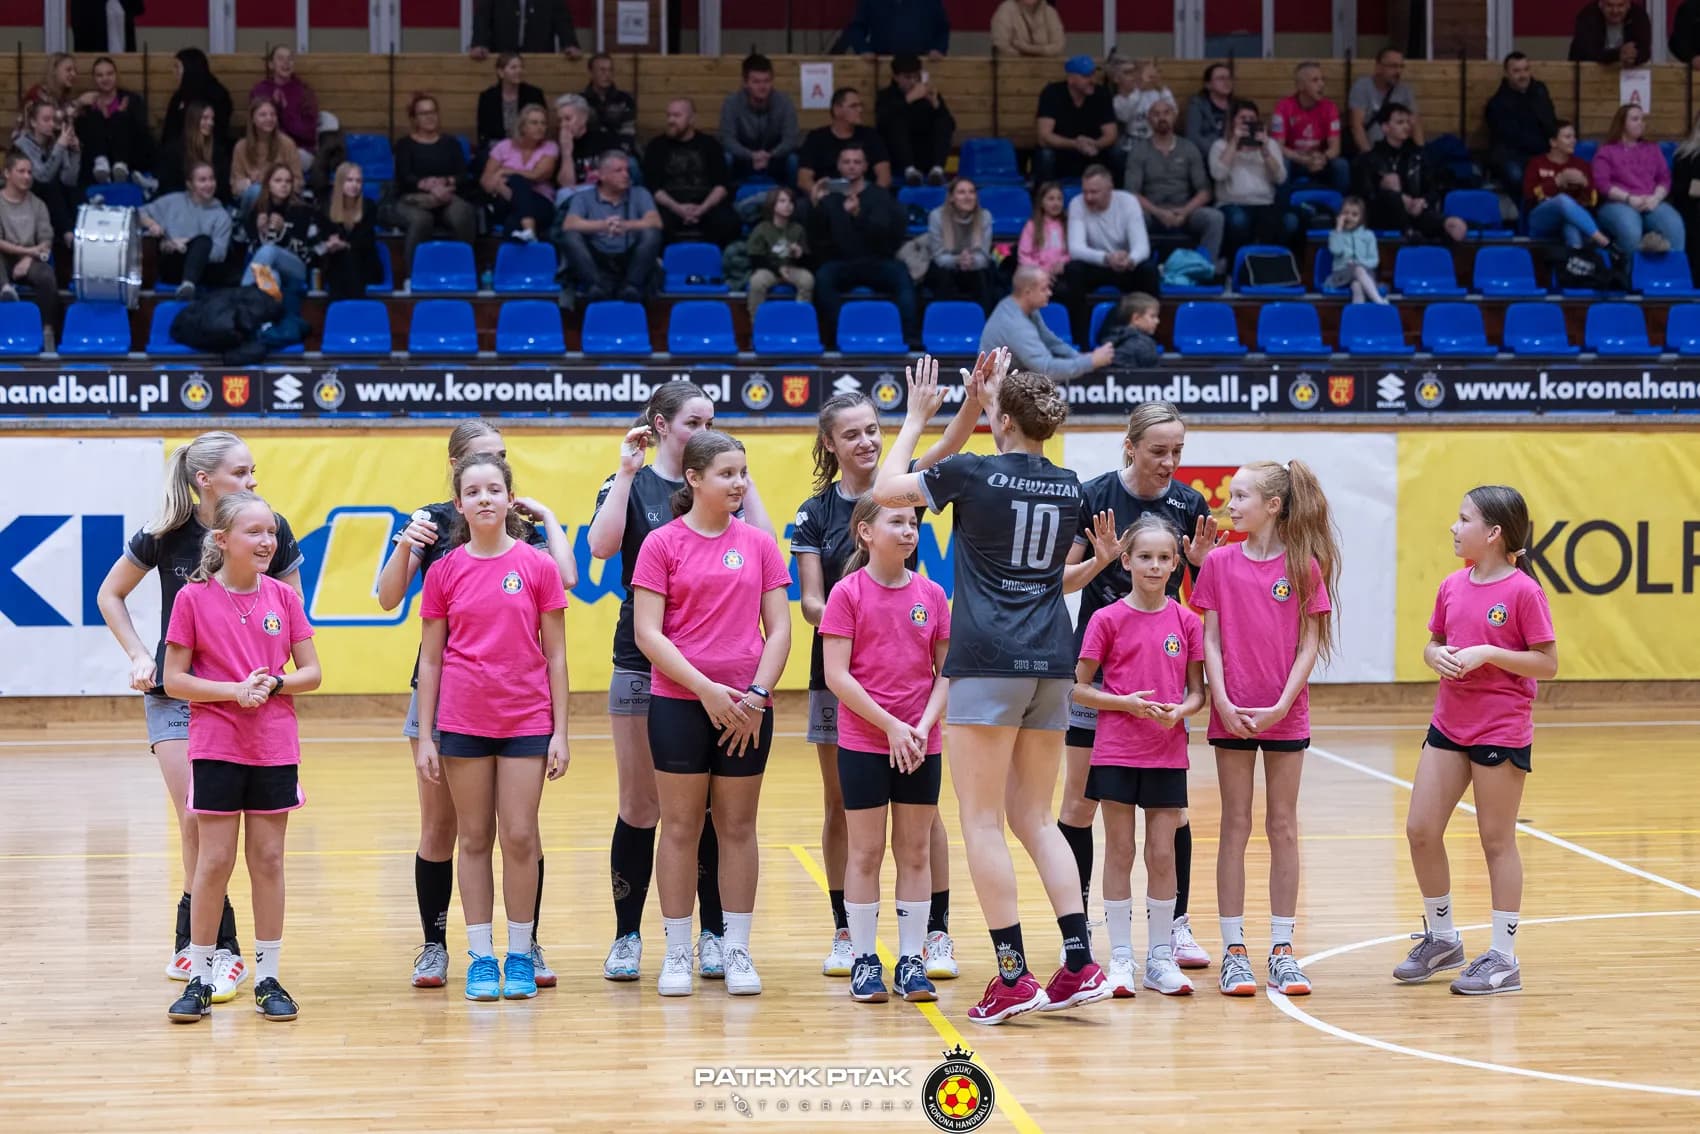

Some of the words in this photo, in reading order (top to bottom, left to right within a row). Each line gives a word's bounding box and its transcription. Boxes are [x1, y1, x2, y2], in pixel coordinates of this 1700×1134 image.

[1455, 372, 1700, 400] www.koronahan
[1008, 476, 1079, 498] LEWIATAN
[1010, 500, 1060, 570] 10
